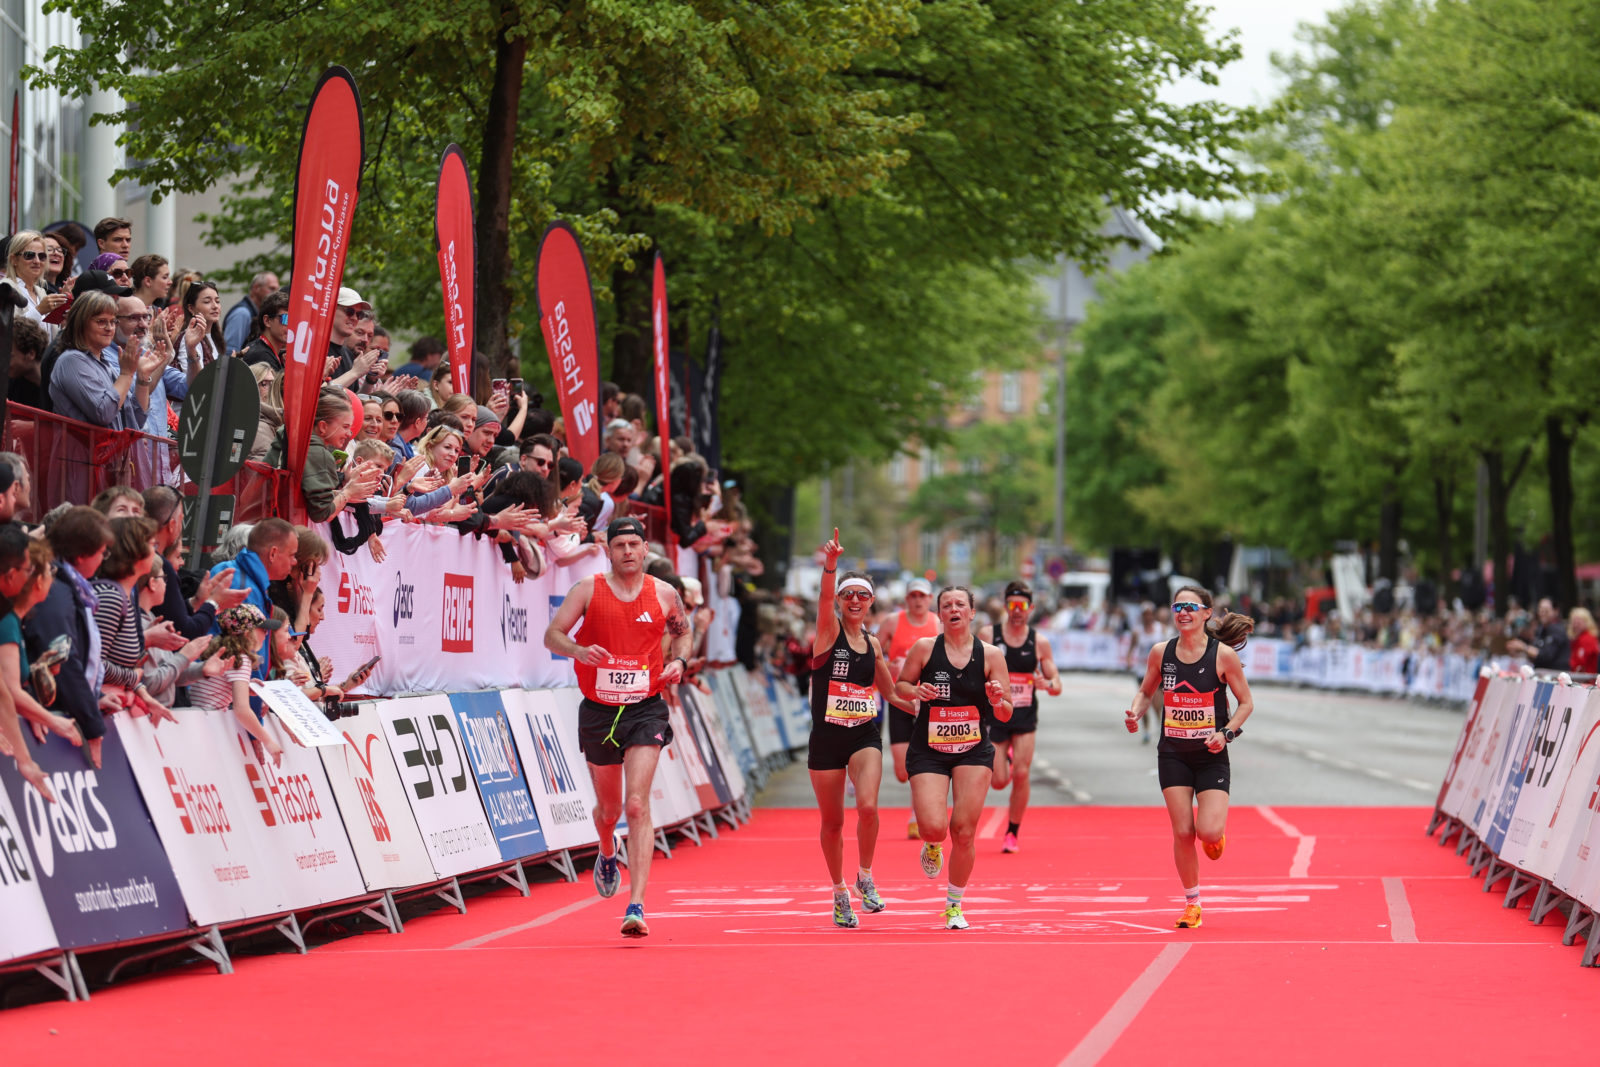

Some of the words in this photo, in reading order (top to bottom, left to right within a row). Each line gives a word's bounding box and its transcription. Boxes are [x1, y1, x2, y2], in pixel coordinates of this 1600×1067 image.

[304, 178, 340, 311] Haspa
[443, 585, 473, 641] REWE
[608, 672, 636, 685] 1327
[617, 659, 639, 667] Haspa
[835, 698, 868, 713] 22003
[848, 687, 867, 696] Haspa
[1180, 696, 1203, 705] Haspa
[269, 688, 321, 738] Marathon
[937, 723, 971, 737] 22003
[1172, 709, 1205, 722] 22003
[49, 770, 117, 853] asics
[175, 767, 232, 852] Haspa
[261, 762, 322, 839] Haspa
[355, 777, 391, 842] LBS
[75, 883, 99, 912] sound
[113, 878, 138, 907] sound
[132, 875, 158, 908] body
